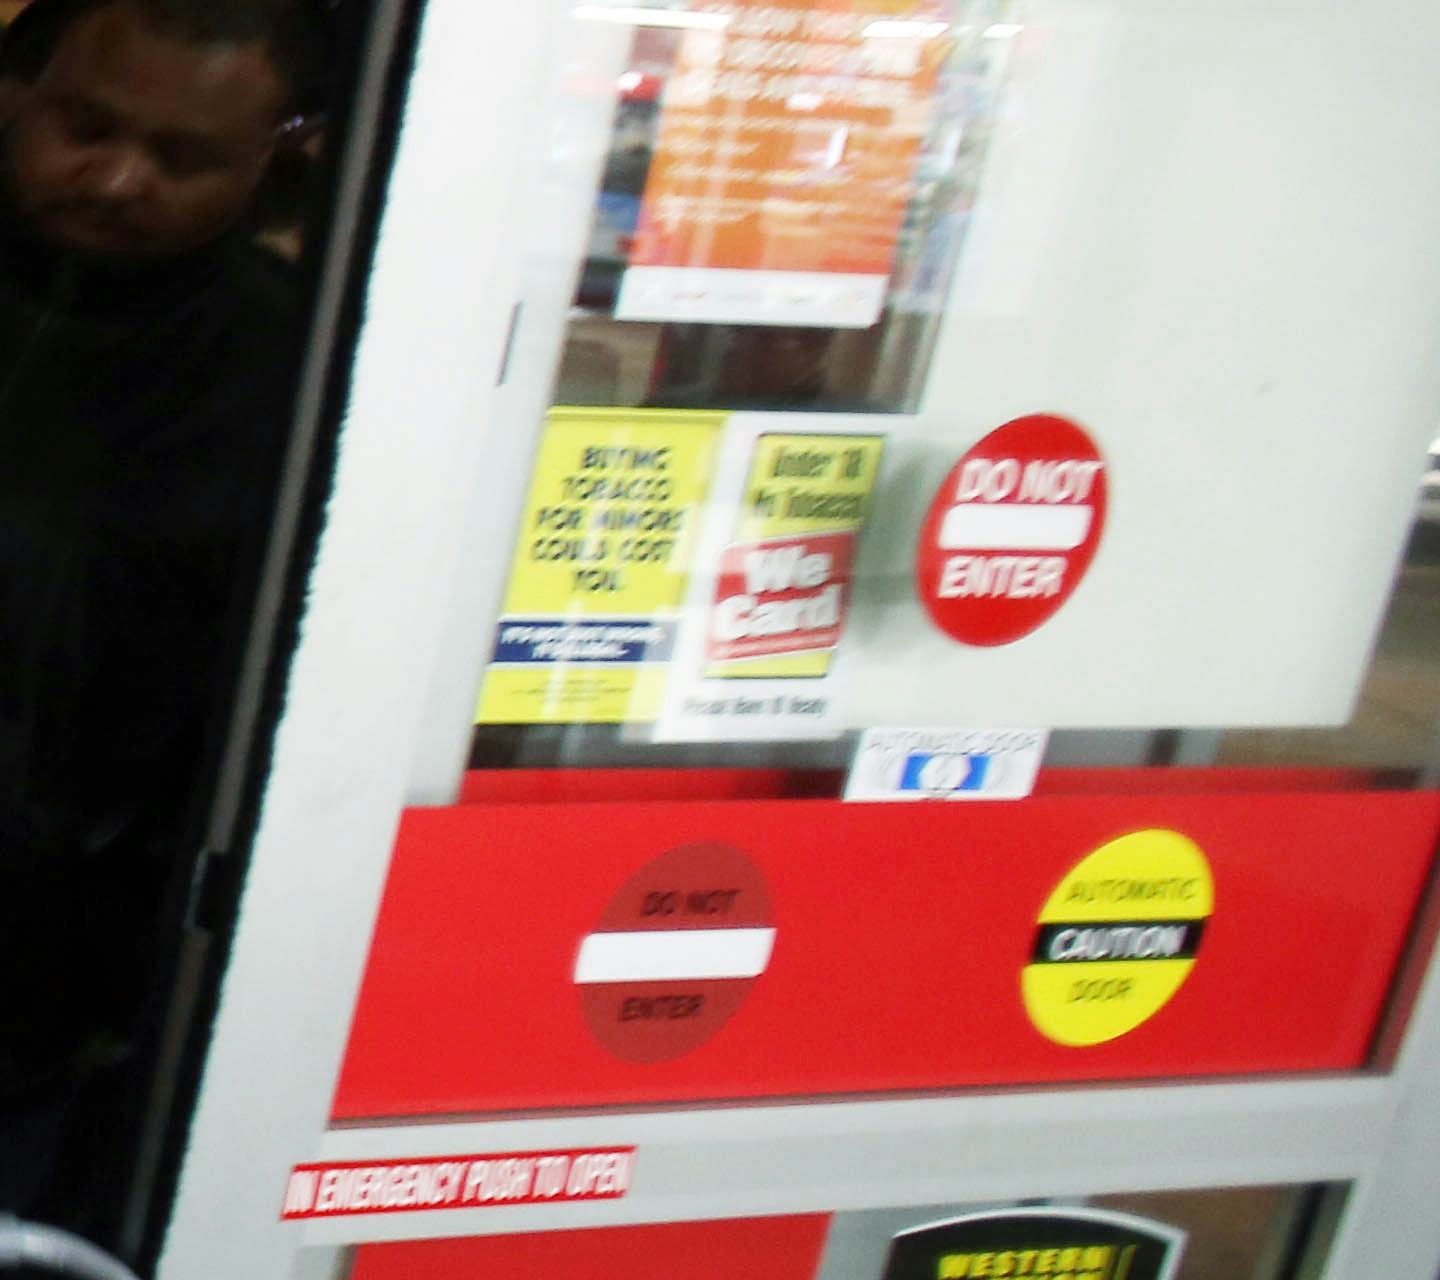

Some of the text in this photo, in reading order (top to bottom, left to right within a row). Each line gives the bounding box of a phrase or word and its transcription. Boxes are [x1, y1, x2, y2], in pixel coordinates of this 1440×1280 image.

[958, 460, 1104, 504] DO NOT
[746, 546, 832, 594] We
[936, 556, 1066, 600] ENTER
[716, 584, 840, 642] Card
[640, 889, 742, 916] DO NOT
[1066, 878, 1198, 902] AUTOMATIC
[1047, 926, 1187, 960] CAUTION
[1068, 977, 1134, 1003] DOOR
[618, 994, 704, 1022] ENTER
[282, 1151, 632, 1212] IN EMERGENCY PUSH TO OPEN
[938, 1246, 1116, 1280] WESTERN
